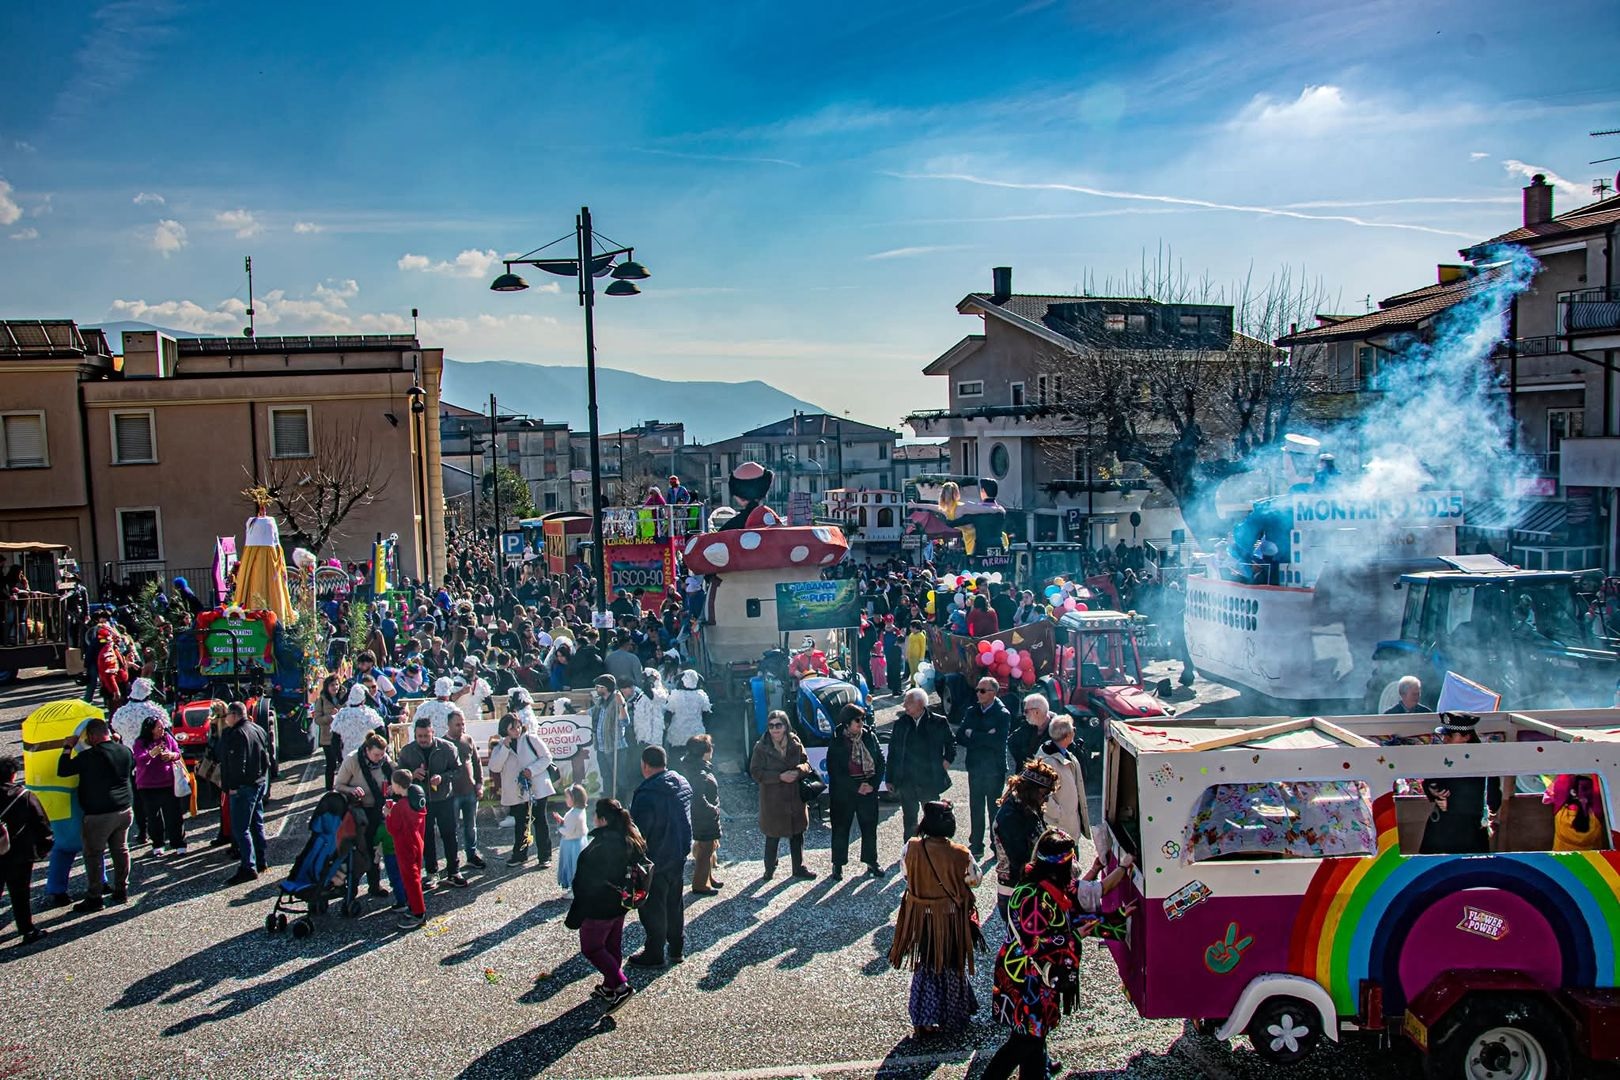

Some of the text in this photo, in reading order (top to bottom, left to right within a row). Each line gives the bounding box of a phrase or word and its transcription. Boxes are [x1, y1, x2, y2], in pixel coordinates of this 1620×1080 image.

[1069, 510, 1078, 523] P
[507, 535, 520, 552] P
[664, 547, 672, 585] 2025
[611, 569, 664, 586] DISCO-90
[806, 581, 838, 591] BANDA
[809, 592, 836, 603] PUFFI
[542, 735, 582, 746] PASQUA
[1467, 920, 1499, 937] POWER
